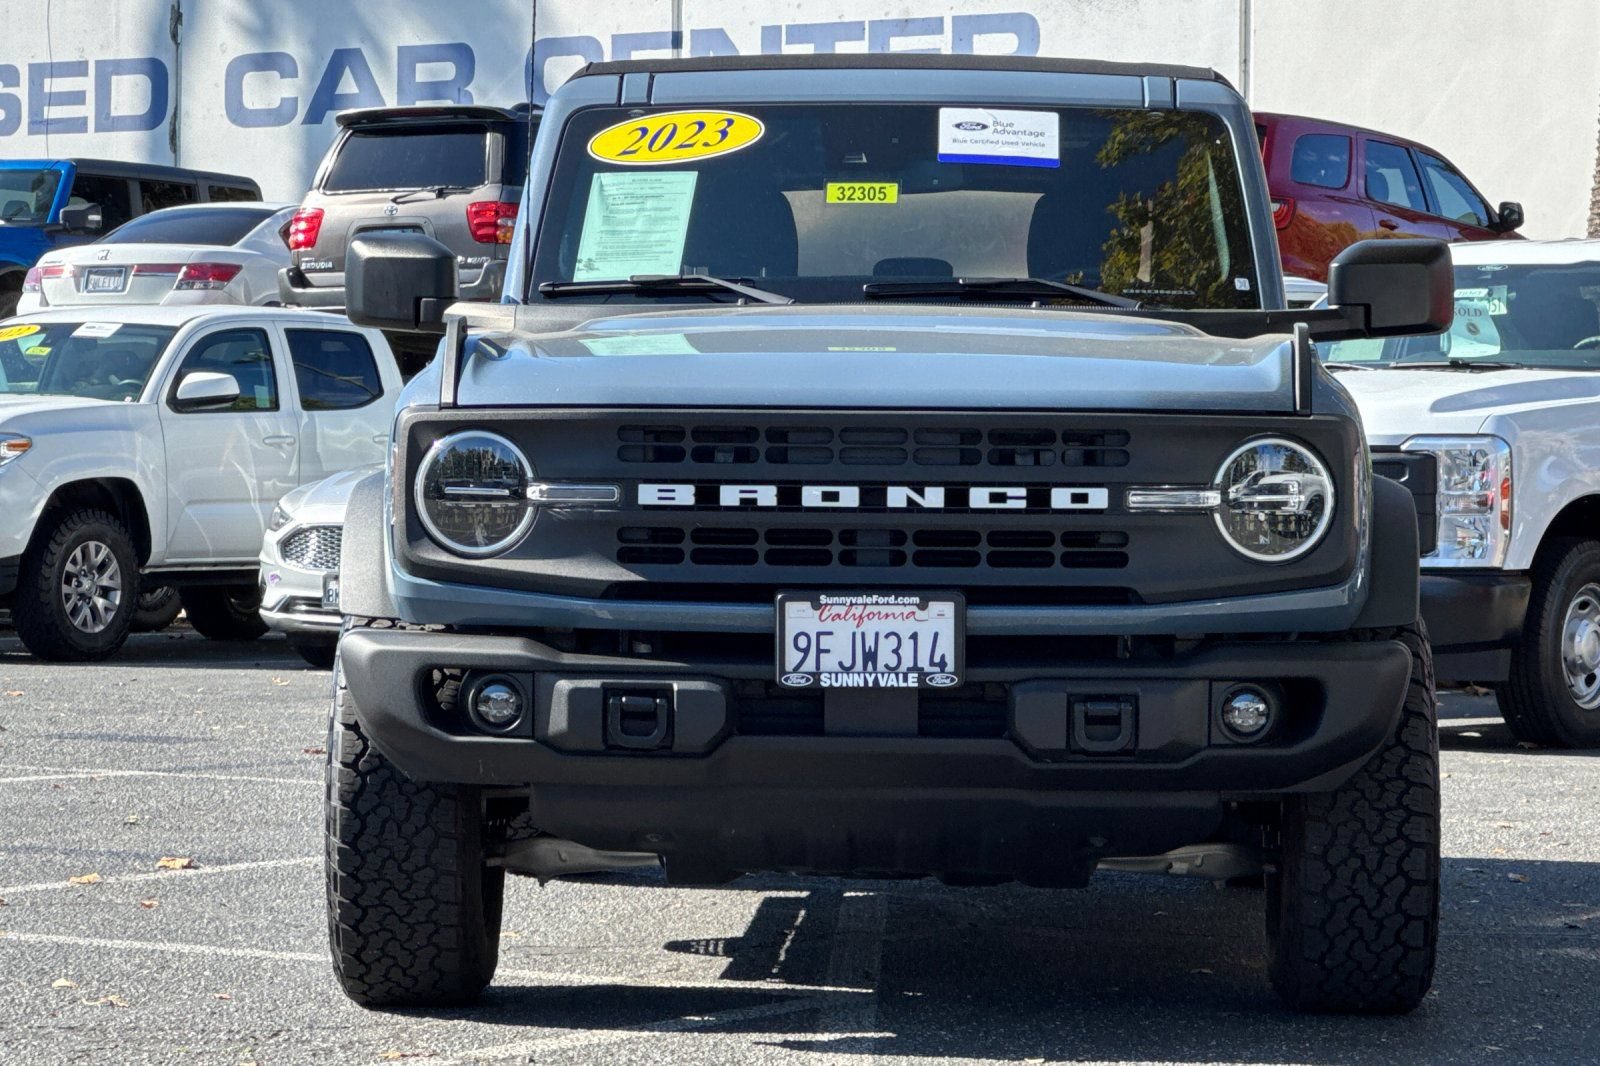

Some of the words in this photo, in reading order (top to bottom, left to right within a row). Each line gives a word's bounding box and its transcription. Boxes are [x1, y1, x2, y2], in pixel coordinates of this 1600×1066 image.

[224, 42, 475, 127] CAR
[992, 120, 1015, 128] Blue
[992, 128, 1046, 138] Advantage
[615, 118, 736, 157] 2023
[836, 186, 887, 201] 32305
[637, 483, 1109, 510] BRONCO
[819, 595, 920, 606] SunnyvaleFord.com
[818, 605, 928, 628] California
[792, 631, 948, 672] 9FJW314
[820, 673, 918, 688] SUNNYVALE
